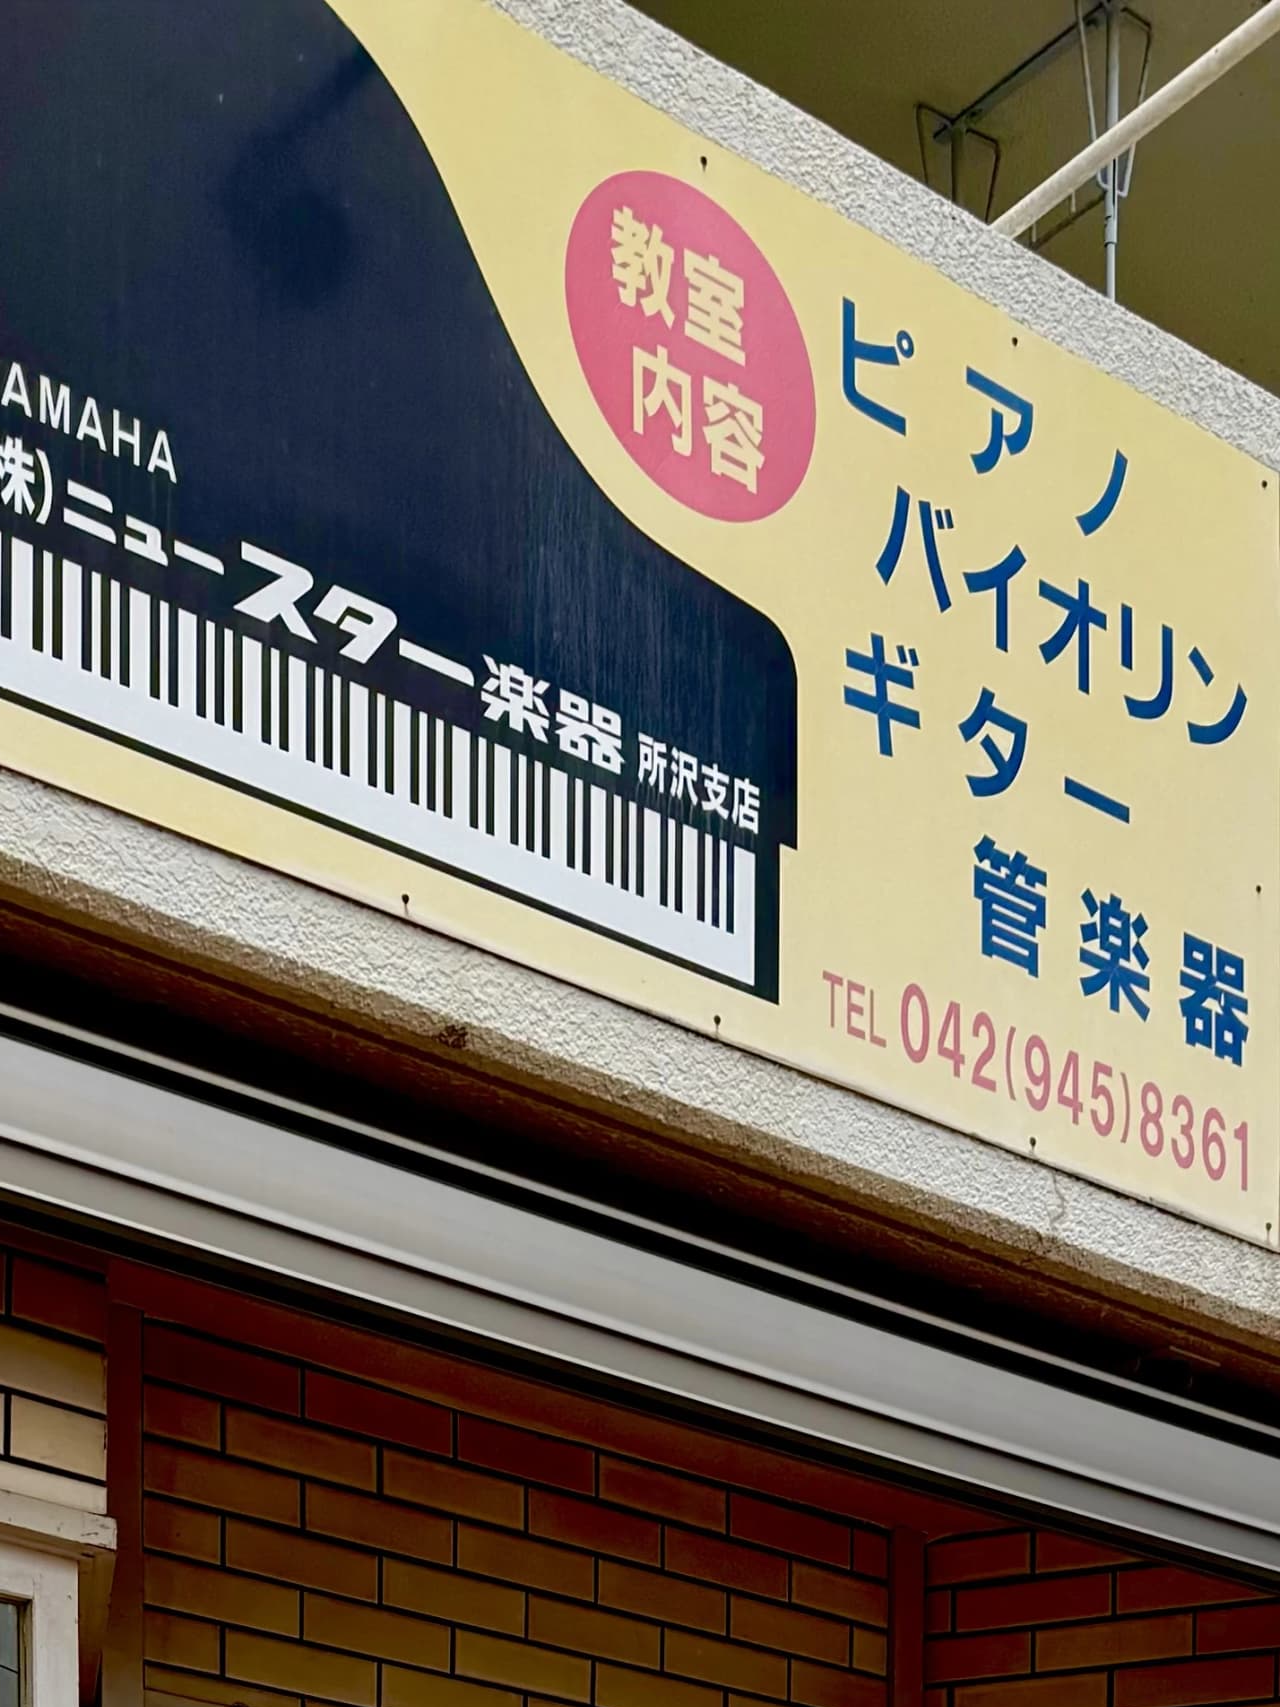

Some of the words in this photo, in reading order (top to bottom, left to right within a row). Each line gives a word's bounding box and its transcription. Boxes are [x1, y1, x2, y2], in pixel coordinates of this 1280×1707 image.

[611, 205, 748, 367] 教室
[629, 347, 766, 495] 内容
[841, 296, 1130, 538] ピアノ
[874, 484, 1248, 746] バイオリン
[637, 730, 762, 836] 所沢支店
[841, 631, 1132, 826] ギター
[973, 834, 1249, 1068] 管楽器
[821, 969, 887, 1049] TEL
[899, 981, 1252, 1193] 042(945)8361
